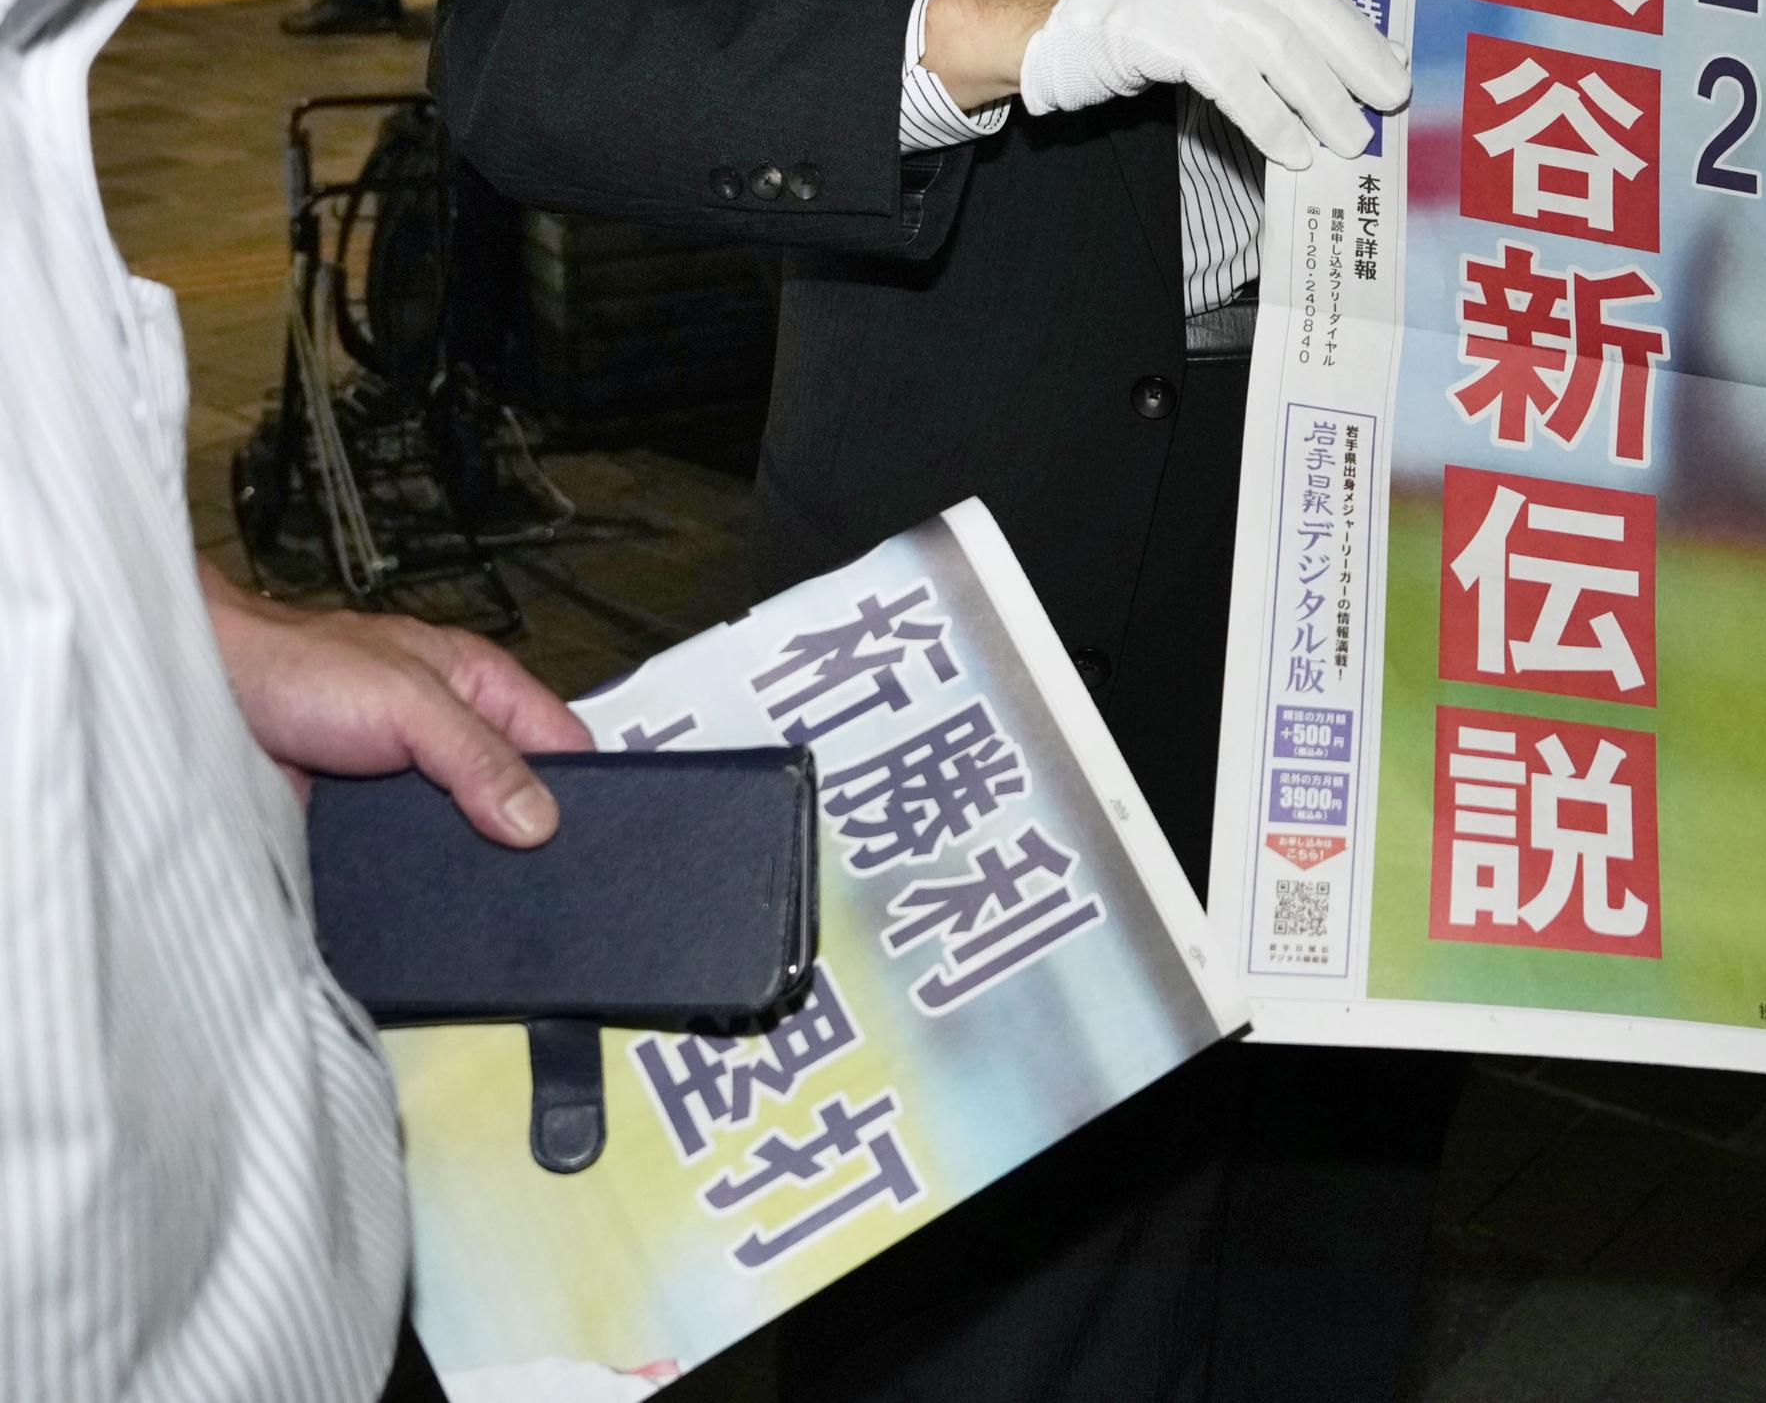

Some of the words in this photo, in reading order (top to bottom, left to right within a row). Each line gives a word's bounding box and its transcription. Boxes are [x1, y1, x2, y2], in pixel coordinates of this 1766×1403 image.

[1353, 174, 1381, 281] 本紙で詳報
[1285, 419, 1340, 694] 岩手日報デジタル版
